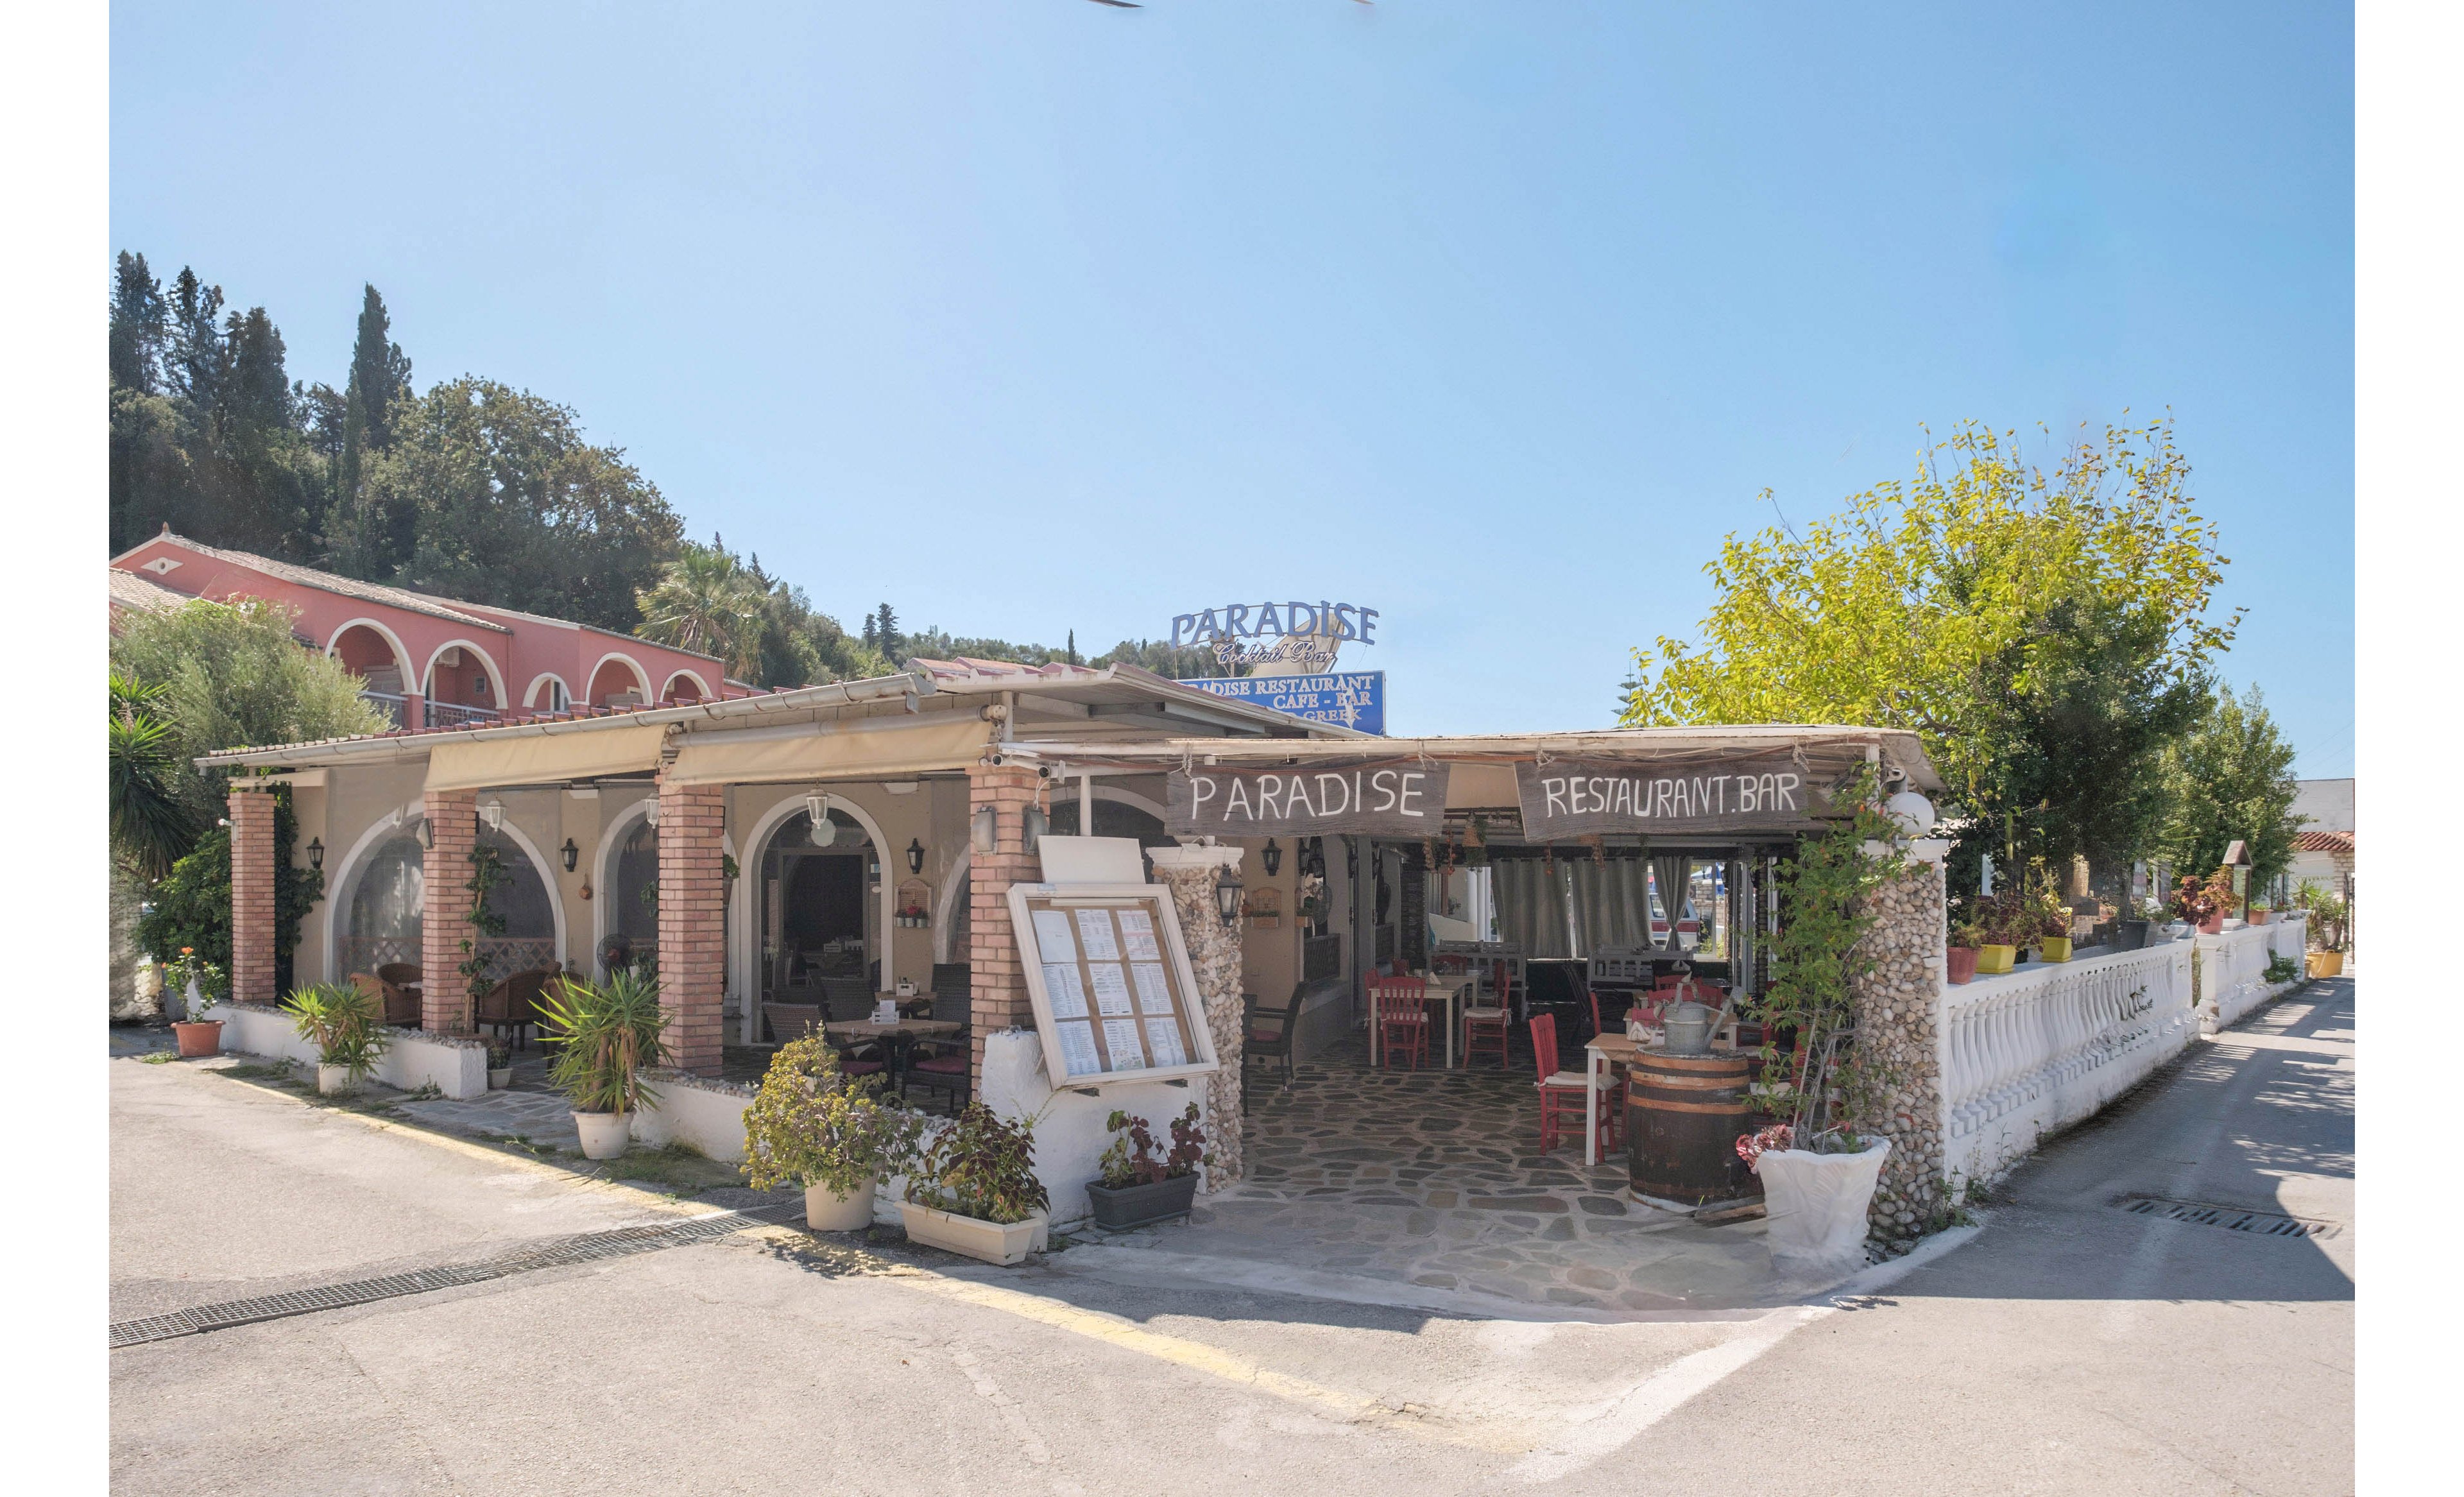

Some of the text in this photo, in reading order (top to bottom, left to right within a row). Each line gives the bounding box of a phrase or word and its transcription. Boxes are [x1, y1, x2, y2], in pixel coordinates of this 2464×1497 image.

[1171, 600, 1380, 650] PARADISE
[1213, 640, 1337, 665] Cocktail Bar
[1186, 675, 1374, 696] ADISE RESTAURANT
[1273, 694, 1319, 709] CAFE
[1336, 691, 1373, 706] BAR
[1303, 709, 1362, 722] GREEK
[1190, 771, 1425, 821] PARADISE
